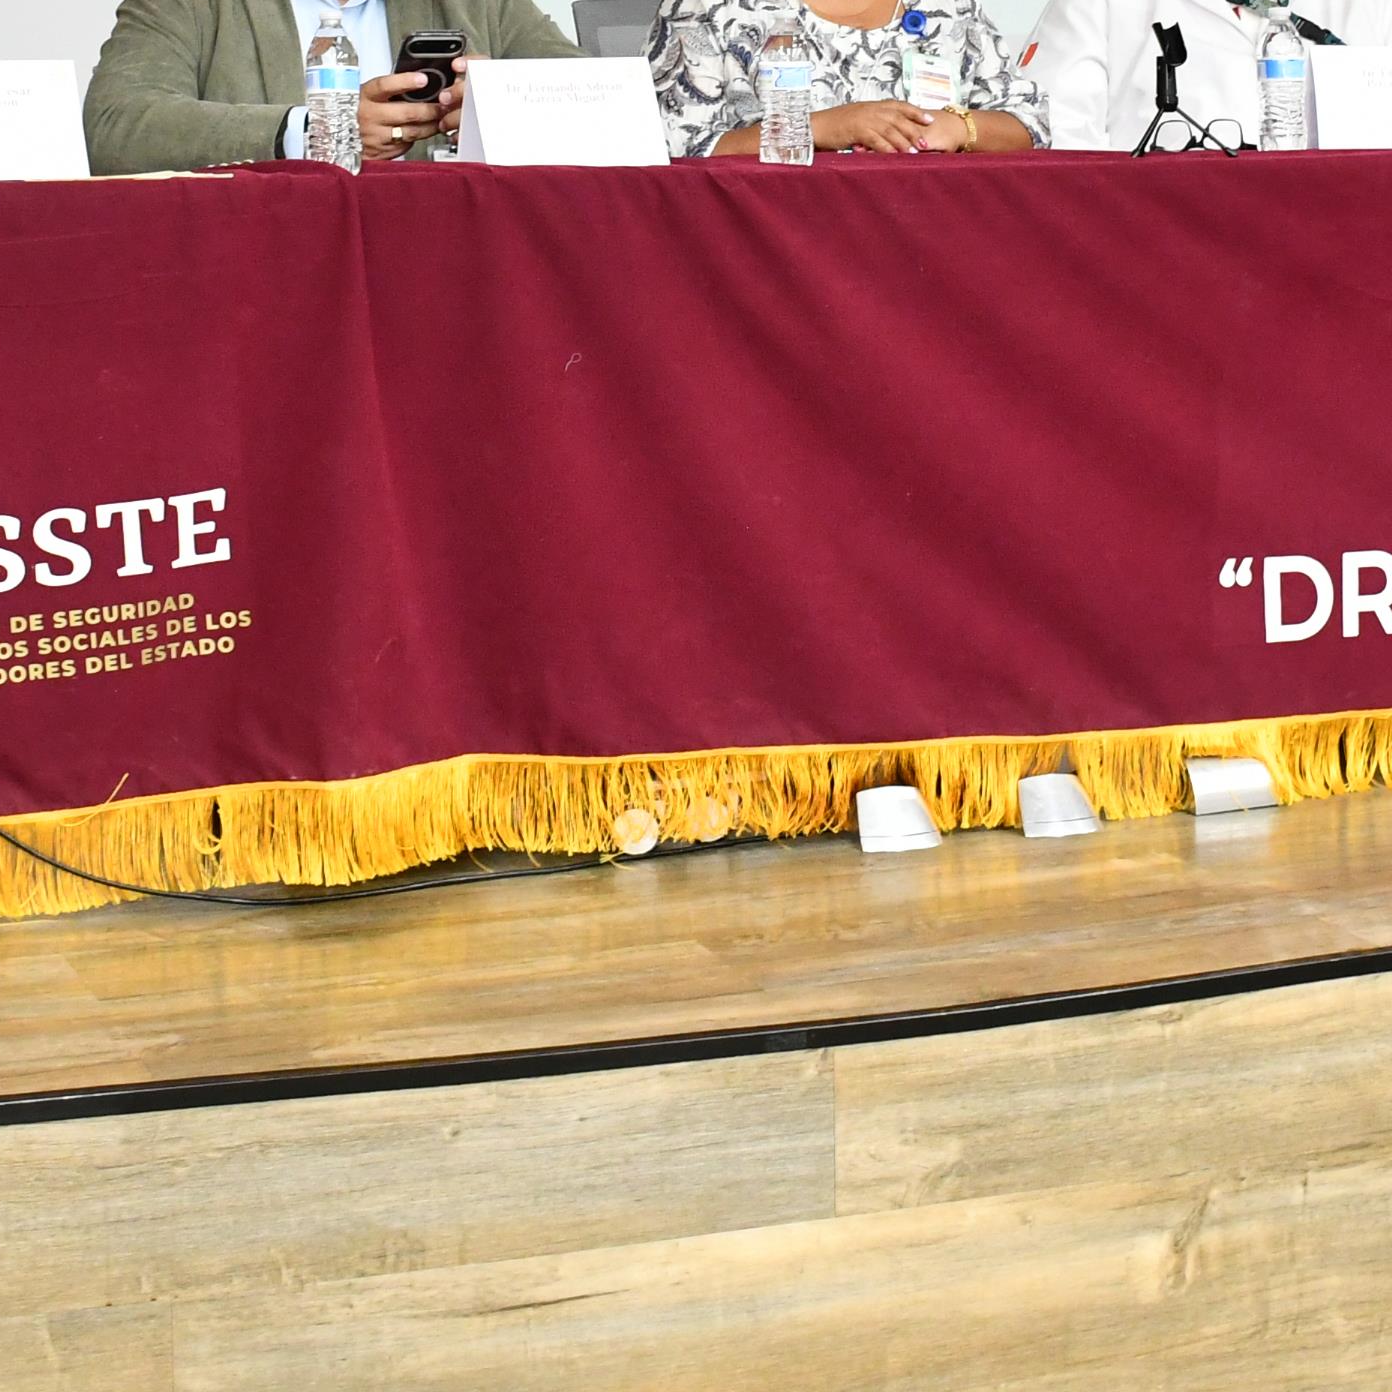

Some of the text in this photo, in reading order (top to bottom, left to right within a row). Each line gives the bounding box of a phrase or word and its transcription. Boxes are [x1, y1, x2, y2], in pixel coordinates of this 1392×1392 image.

[10, 614, 44, 634] DE
[53, 592, 195, 629] SEGURIDAD
[37, 623, 158, 655] SOCIALES
[166, 615, 196, 636] DE
[206, 609, 251, 631] LOS
[85, 653, 133, 675] DEL
[141, 636, 235, 666] ESTADO
